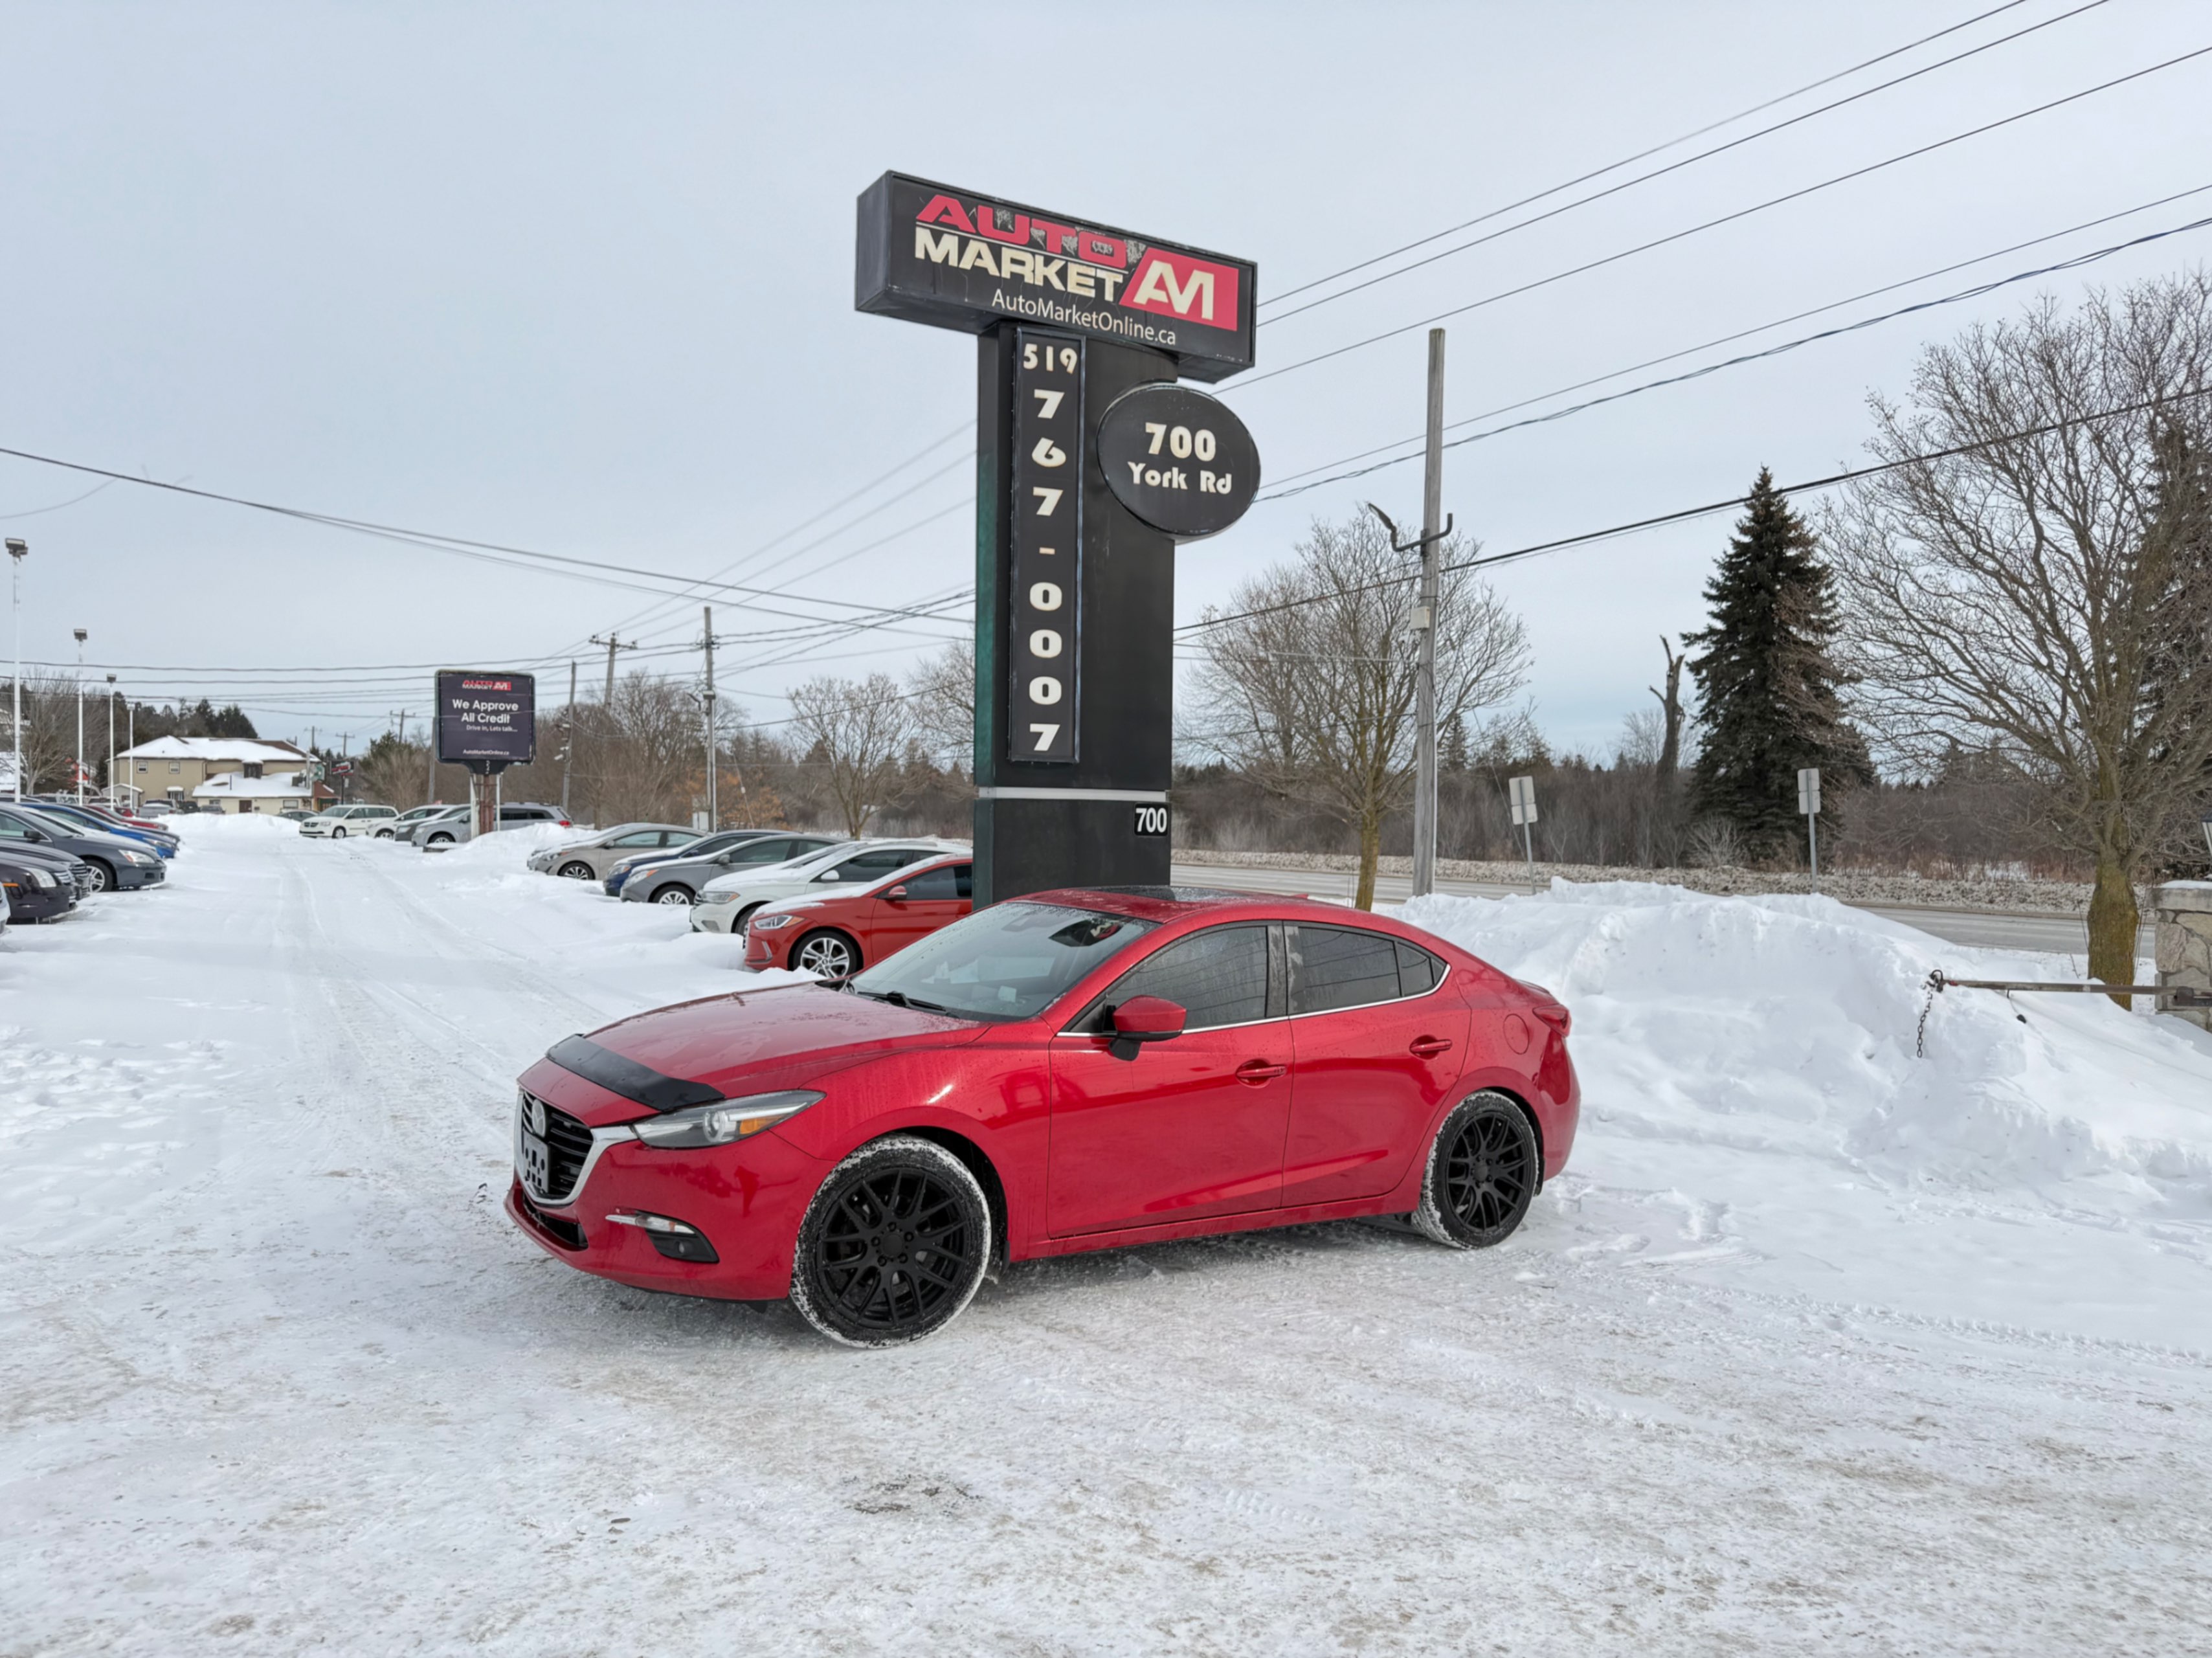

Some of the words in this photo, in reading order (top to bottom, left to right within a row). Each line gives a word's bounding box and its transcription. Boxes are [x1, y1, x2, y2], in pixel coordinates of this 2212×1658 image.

[915, 194, 1127, 268] AUTO
[915, 226, 1123, 302] MARKET
[992, 288, 1176, 345] AutoMarketOnline.ca
[1023, 344, 1078, 374] 519
[1145, 422, 1216, 462] 700
[1128, 462, 1187, 489] York
[1200, 469, 1232, 495] Rd
[452, 699, 469, 708] We
[473, 700, 519, 711] Approve
[461, 713, 475, 722] All
[478, 713, 510, 723] Credit
[1135, 807, 1167, 834] 700
